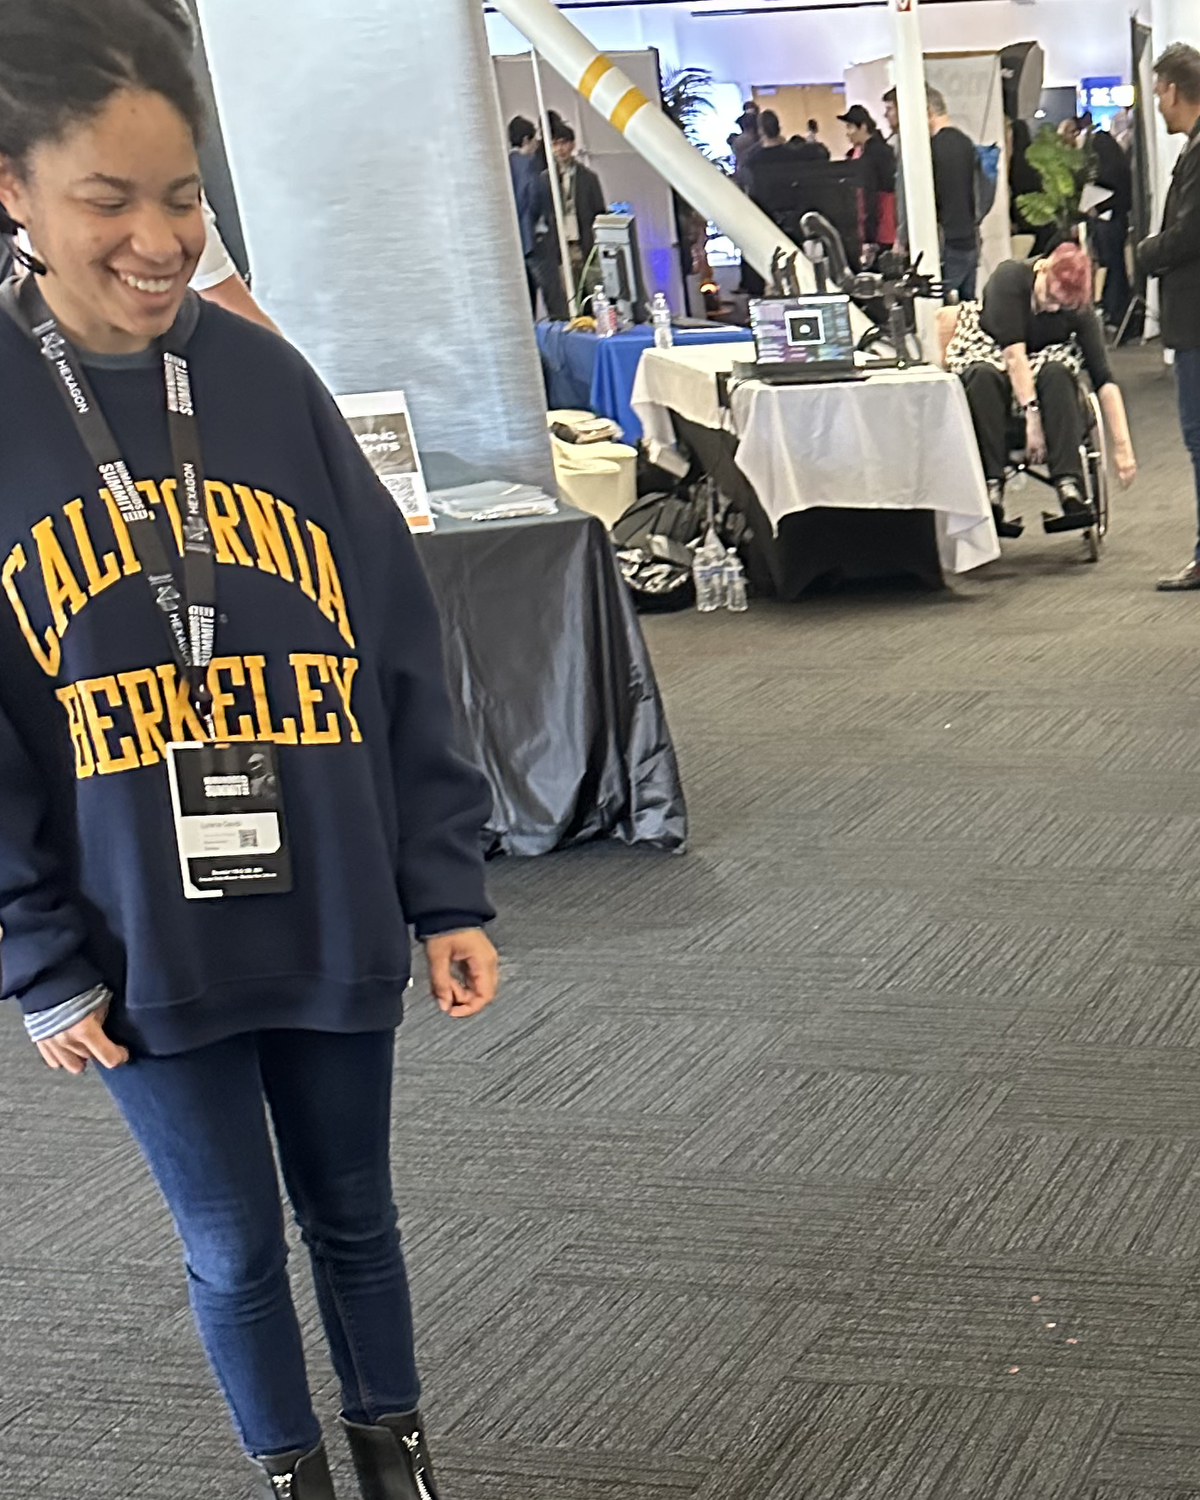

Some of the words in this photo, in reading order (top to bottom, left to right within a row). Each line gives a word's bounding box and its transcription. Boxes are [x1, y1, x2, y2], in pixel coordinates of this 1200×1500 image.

[56, 360, 89, 414] HEXAGON
[99, 462, 134, 511] SUMMIT
[113, 460, 145, 510] HUMANOIDS
[183, 463, 199, 514] HEXAGON
[168, 613, 191, 667] HEXAG
[55, 653, 363, 779] BERKELEY
